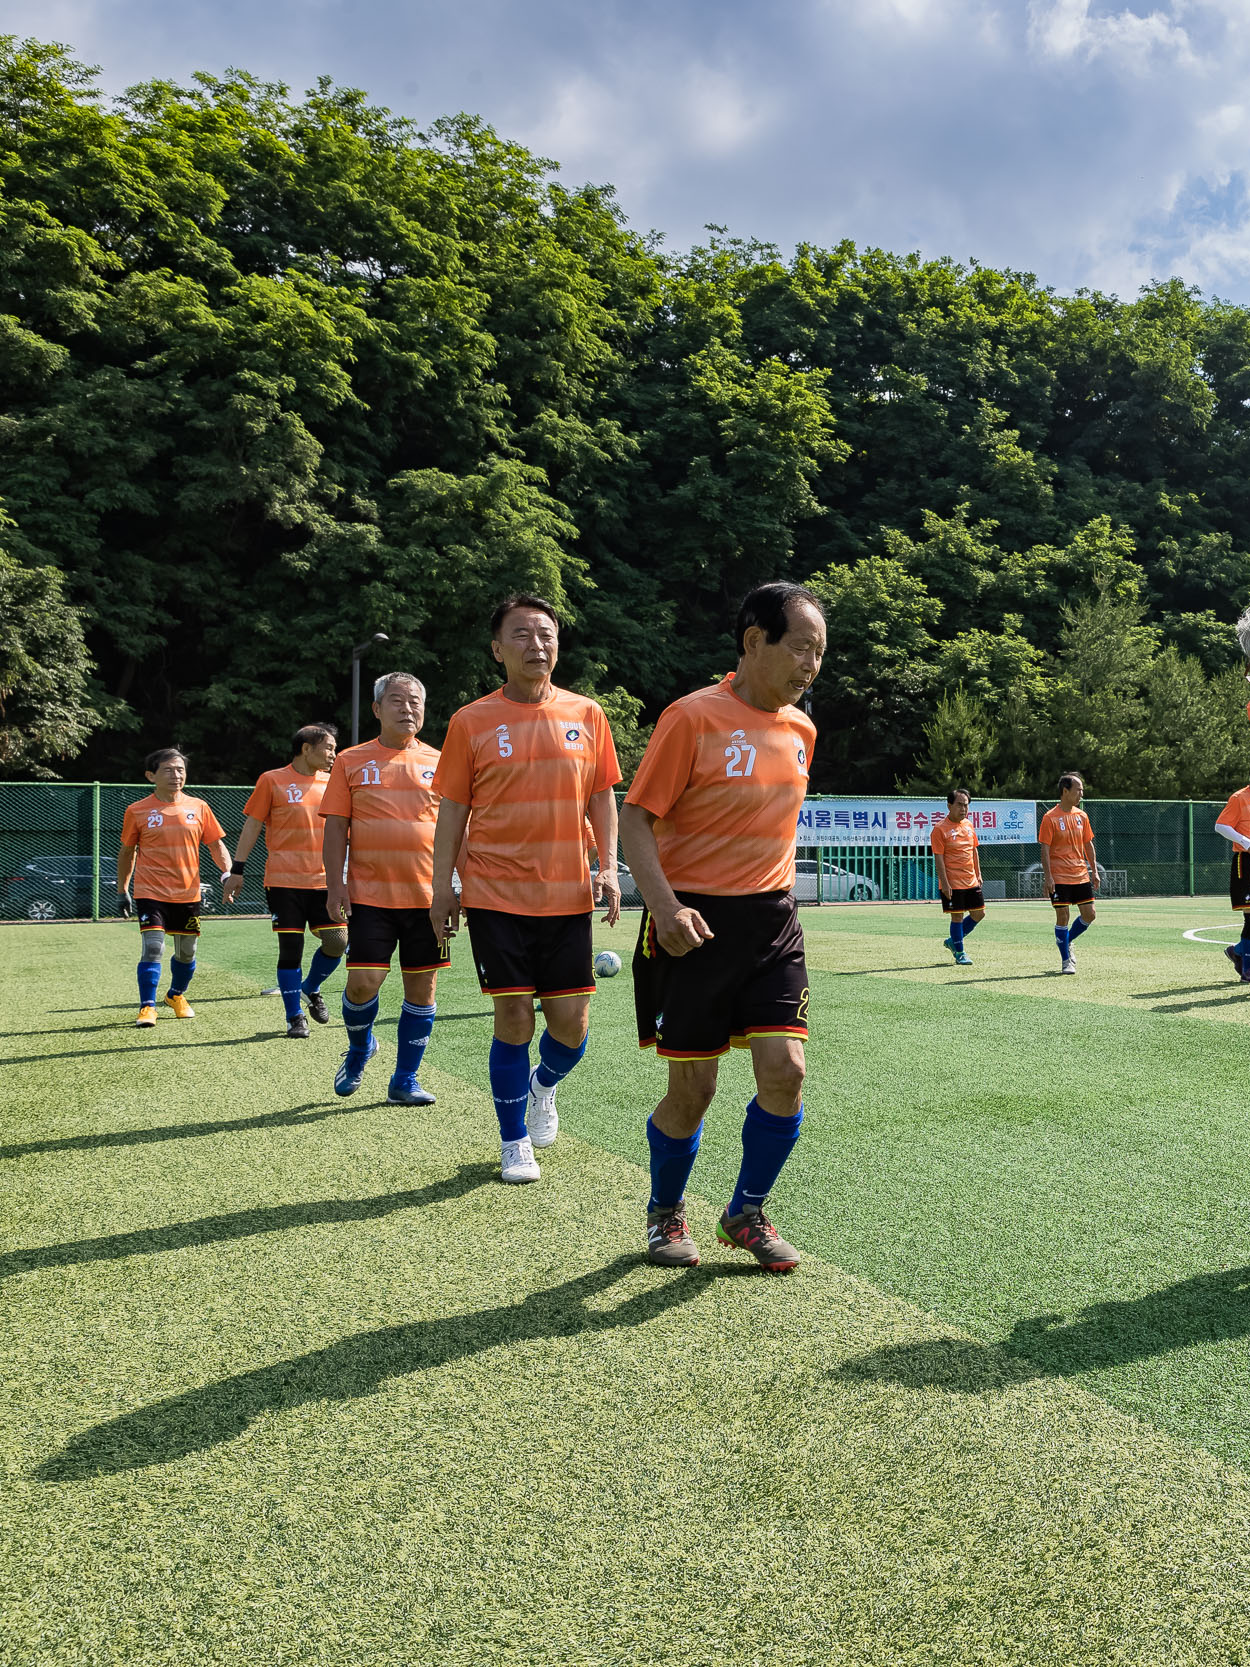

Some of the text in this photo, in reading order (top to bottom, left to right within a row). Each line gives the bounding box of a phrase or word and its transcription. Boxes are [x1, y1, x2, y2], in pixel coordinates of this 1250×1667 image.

[559, 721, 583, 730] SEOUL
[498, 735, 513, 758] 5
[724, 744, 757, 777] 27
[360, 767, 381, 785] 11
[286, 788, 304, 804] 12
[147, 814, 164, 828] 29
[797, 810, 997, 829] 서울특별시 장수축대회
[1003, 821, 1024, 830] SSC
